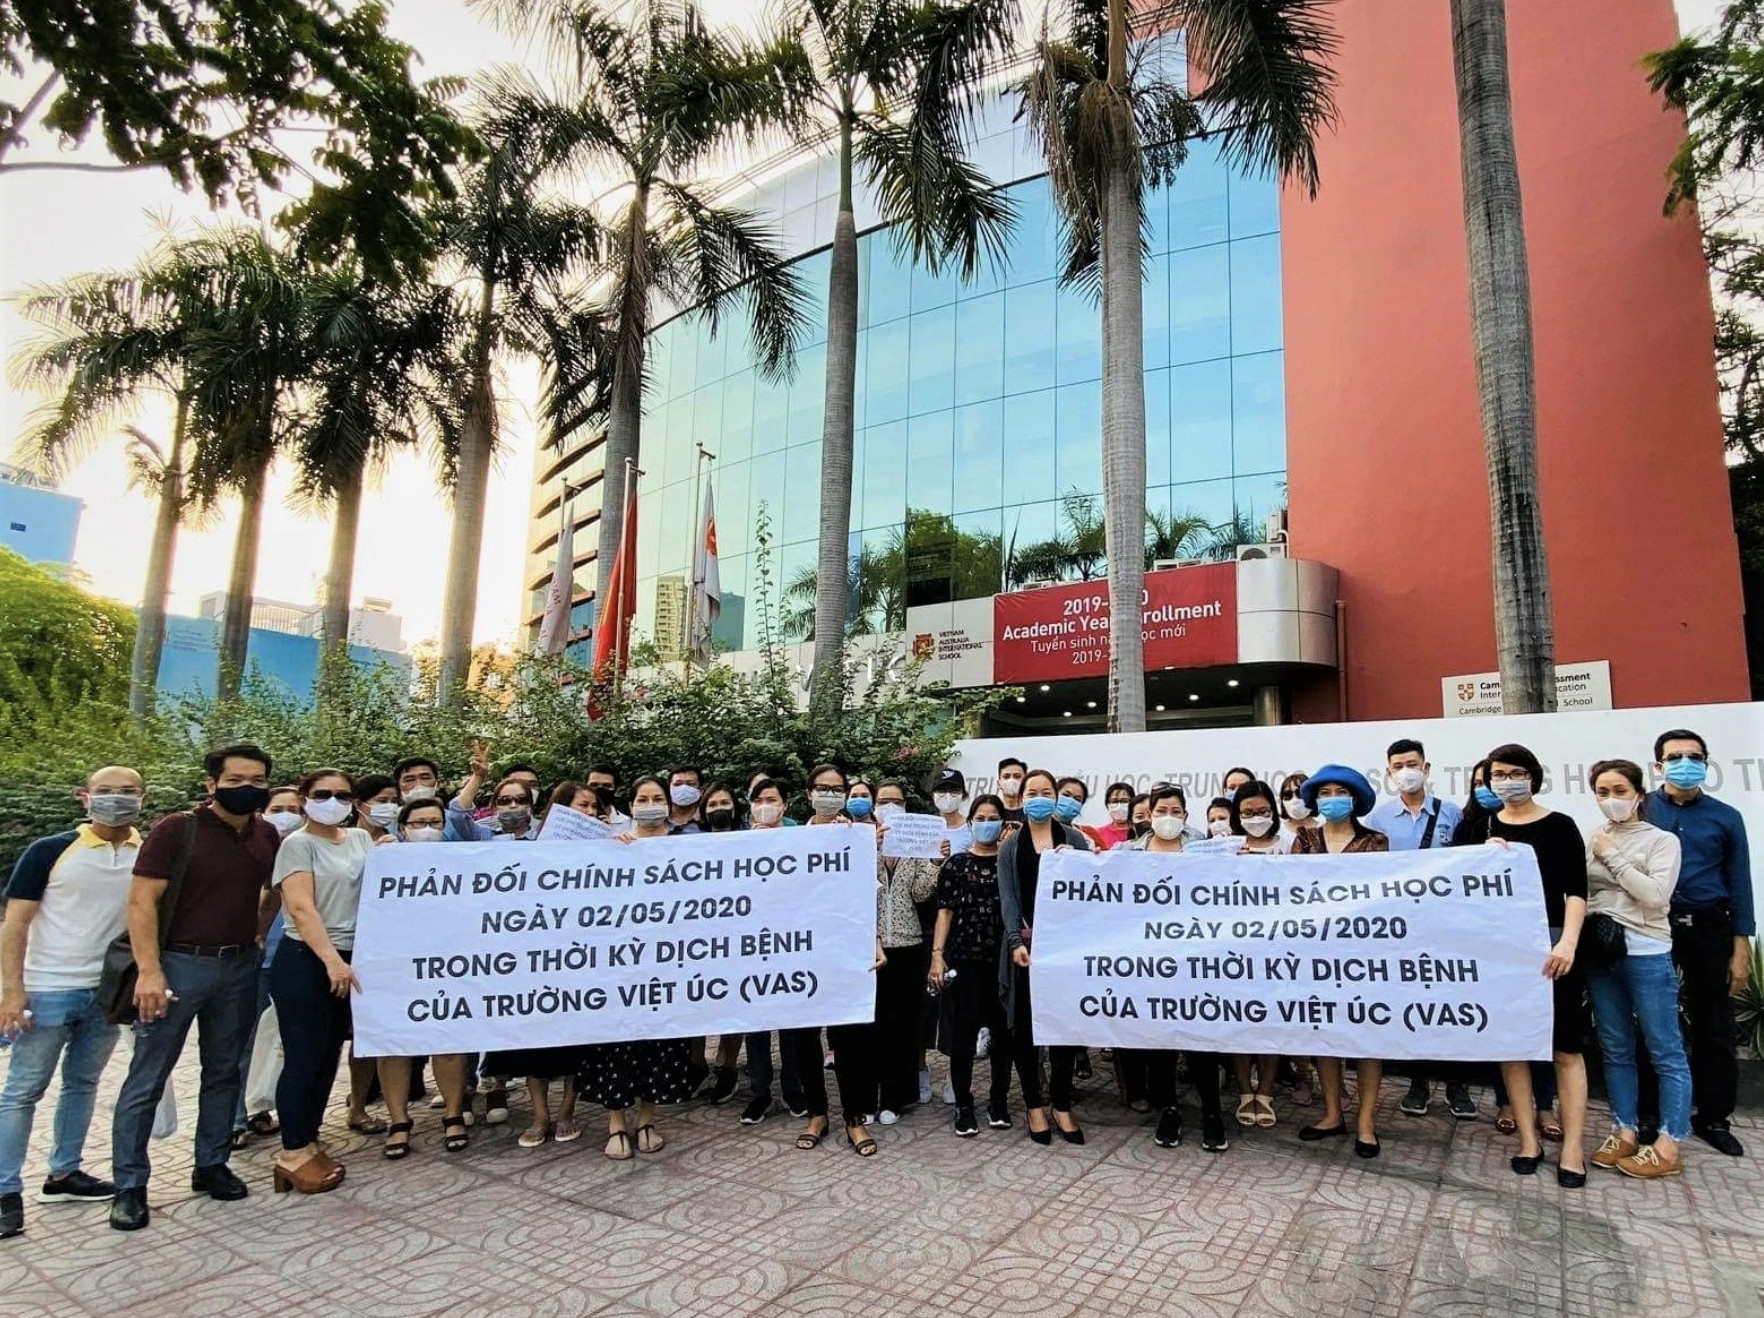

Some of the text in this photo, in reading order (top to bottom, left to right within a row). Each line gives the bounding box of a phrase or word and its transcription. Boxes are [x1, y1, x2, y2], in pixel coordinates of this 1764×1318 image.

[939, 629, 964, 637] VIETNAM
[1002, 618, 1076, 640] Academic
[1079, 614, 1109, 632] Yea
[1141, 600, 1221, 625] rollment
[1070, 634, 1096, 649] sinh
[1141, 630, 1156, 643] ọc
[1160, 623, 1186, 639] mới
[939, 637, 969, 645] AUSTRALIA
[939, 642, 983, 652] INTERNATIONAL
[1555, 672, 1591, 682] ssment
[1459, 697, 1593, 715] Cambridge School
[378, 845, 852, 900] PHẢN ĐỐI CHÍNH SÁCH HỌC PHÍ
[1051, 867, 1514, 907] PHẢN ĐỐI CHÍNH SÁCH HỌC PHÍ
[480, 894, 752, 935] NGÀY 02/05/2020
[1144, 915, 1408, 942] NGÀY 02/05/2020
[411, 926, 813, 980] TRONG THỜI KỲ DỊCH BỆNH
[1083, 949, 1479, 990] TRONG THỜI KỲ DỊCH BỆNH
[407, 969, 819, 1023] CỦA TRƯỜNG VIỆT ÚC (VAS)
[1079, 987, 1489, 1034] CỦA TRƯỜNG VIỆT ÚC (VAS)
